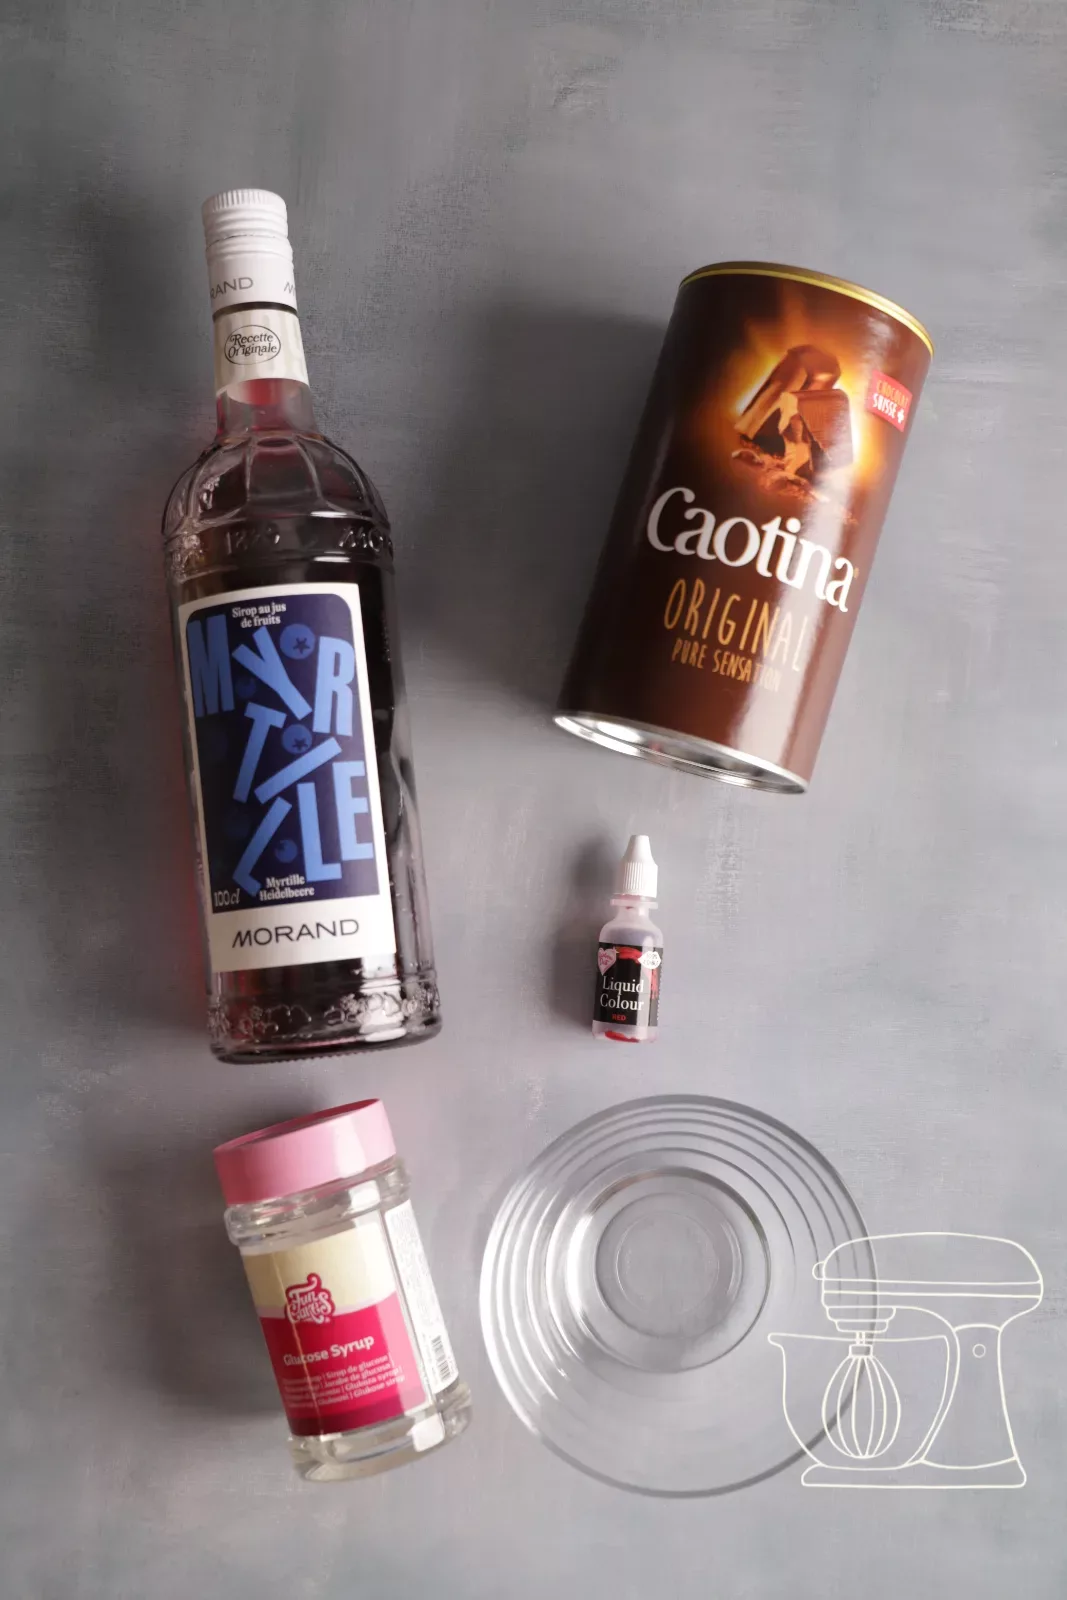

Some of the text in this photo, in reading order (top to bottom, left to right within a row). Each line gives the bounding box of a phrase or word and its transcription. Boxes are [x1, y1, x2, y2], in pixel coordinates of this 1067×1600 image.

[229, 333, 274, 347] Recette
[228, 342, 277, 358] Originale
[647, 487, 854, 612] Caotina
[232, 602, 287, 618] Sirop au jus
[240, 614, 281, 628] de fruits
[664, 578, 808, 672] ORIGINAL
[671, 638, 781, 692] PURE SENSATION
[266, 873, 305, 889] Myrtille
[259, 886, 315, 901] Heidelbeere
[232, 919, 359, 949] MORAND
[602, 976, 645, 995] Liquid
[600, 993, 645, 1011] Colour
[283, 1335, 375, 1366] Glucose Syrup
